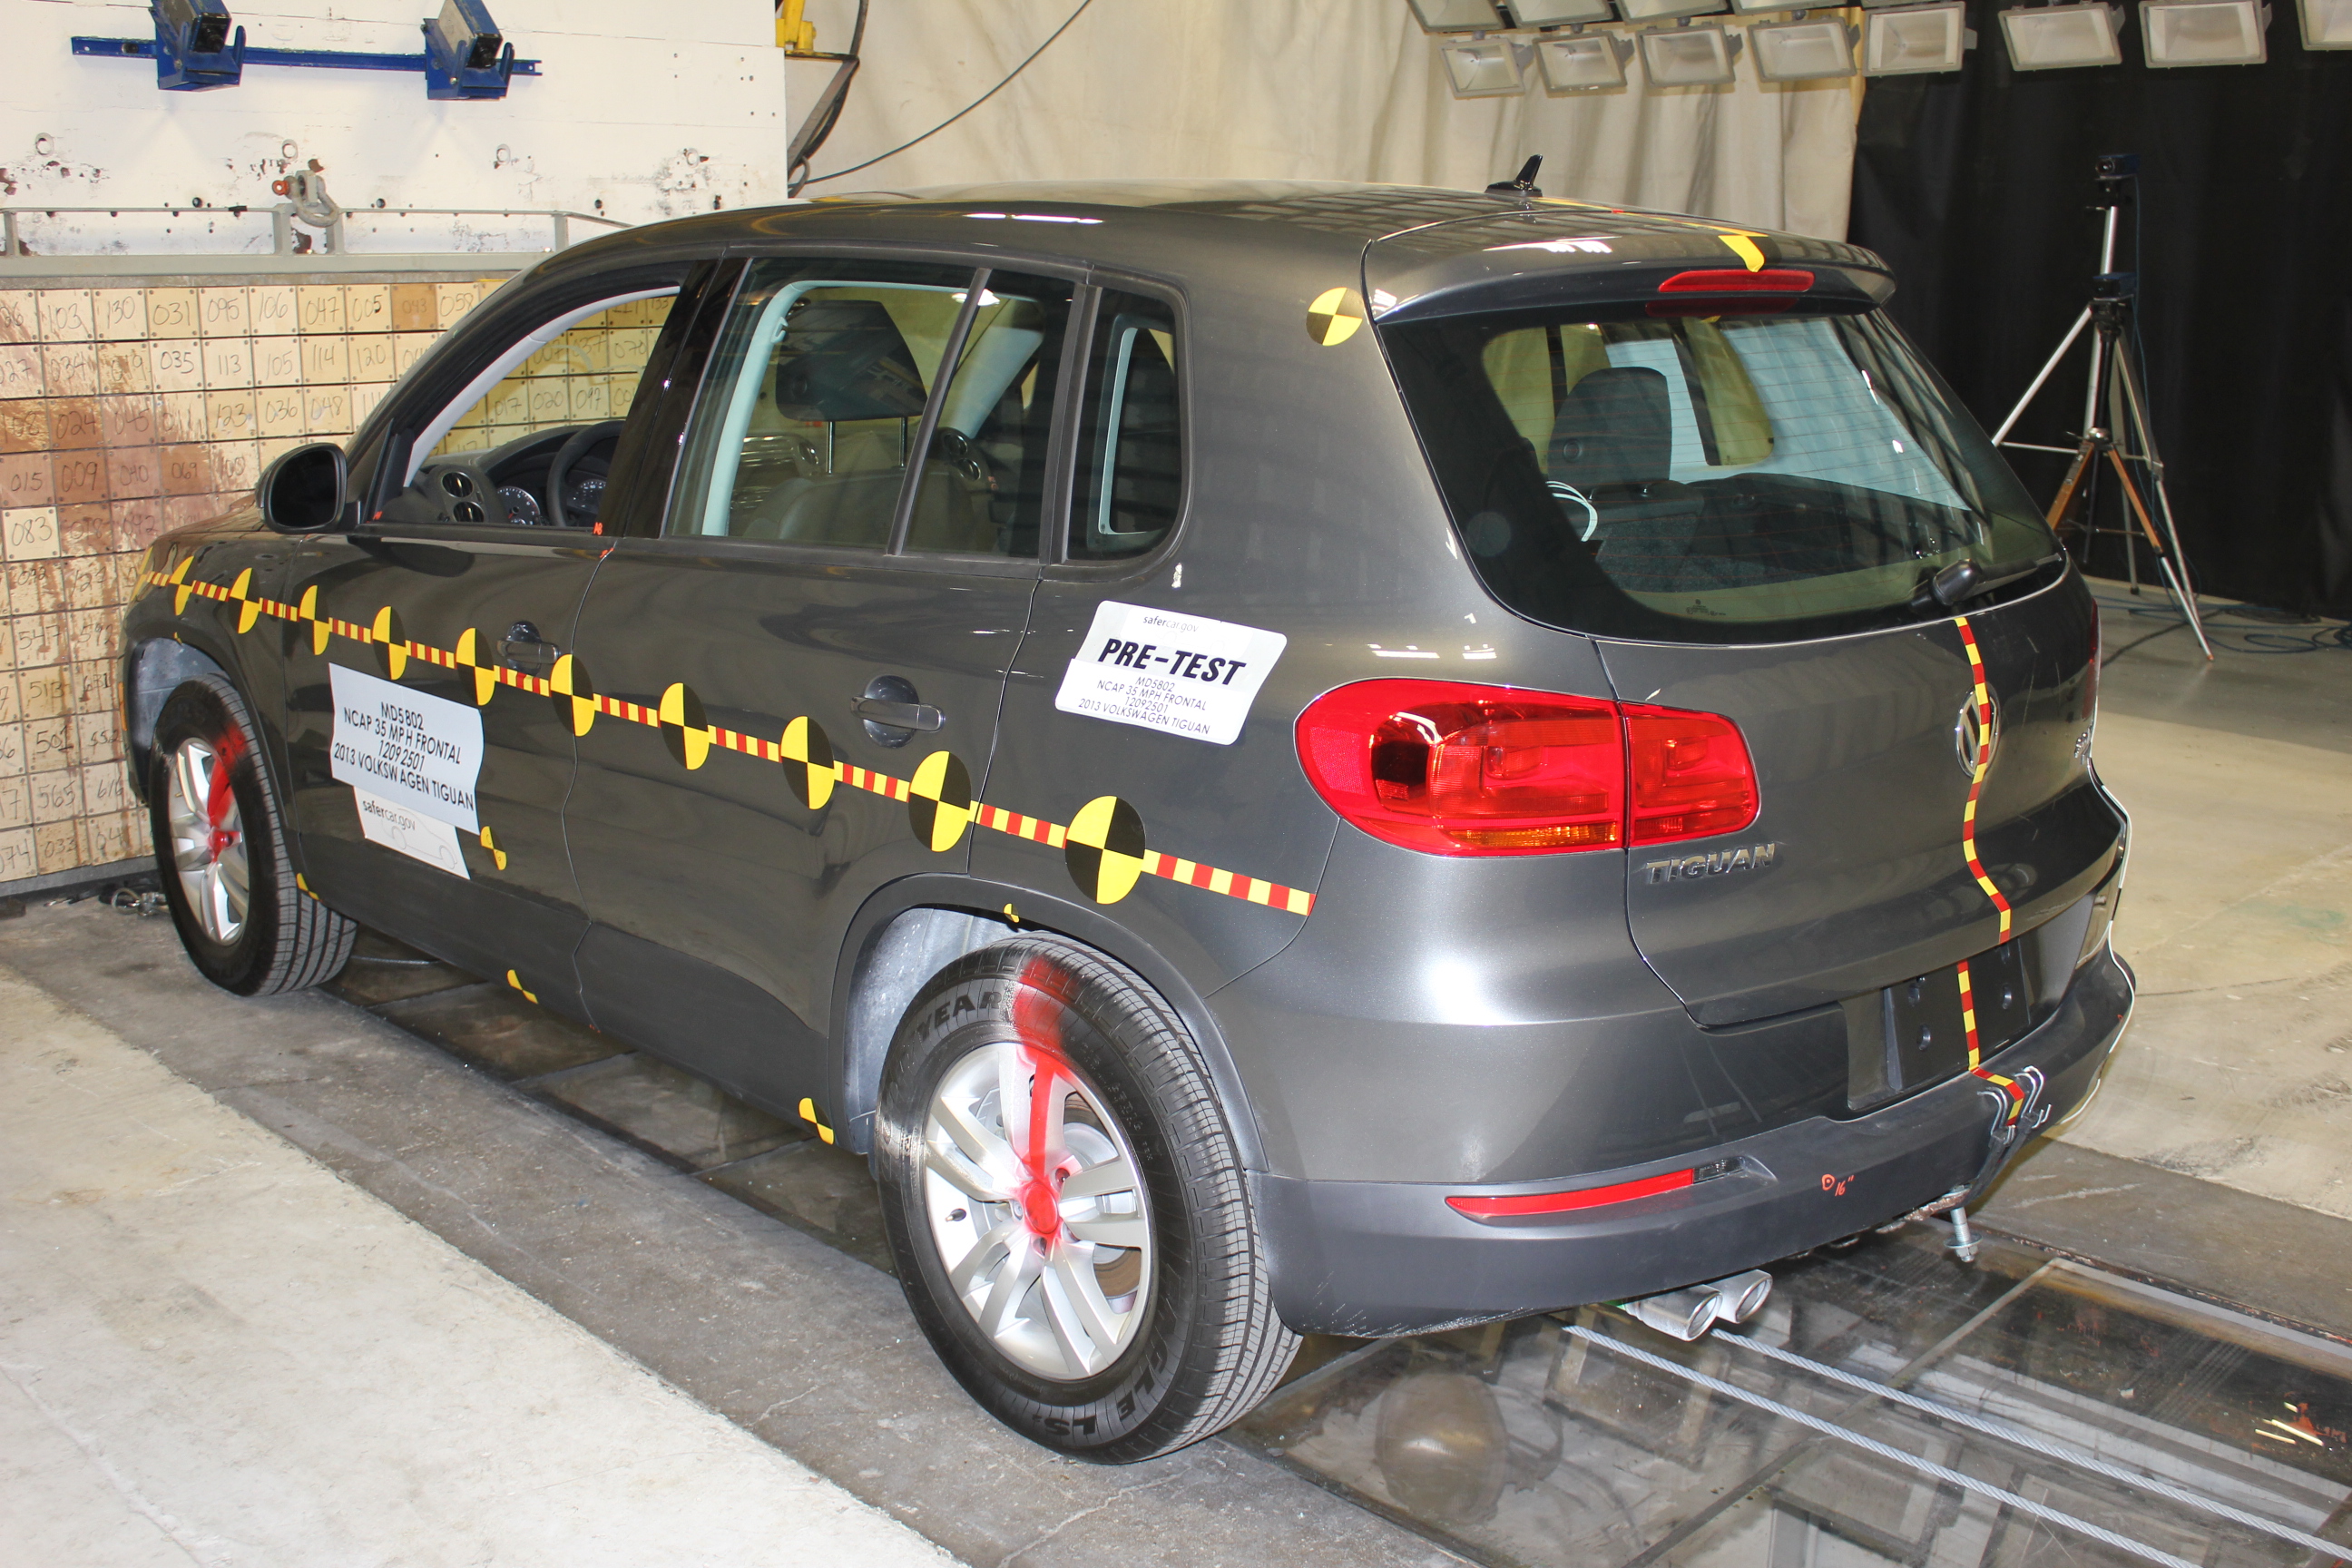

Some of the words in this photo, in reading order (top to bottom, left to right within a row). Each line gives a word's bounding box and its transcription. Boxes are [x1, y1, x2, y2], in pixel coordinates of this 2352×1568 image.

[107, 296, 135, 328] 130
[153, 300, 191, 326] 031
[207, 298, 240, 323] 095
[259, 291, 289, 322] 106
[305, 296, 340, 325] 047
[353, 294, 383, 322] 005
[402, 298, 427, 314] 043
[439, 292, 474, 317] 058
[313, 343, 335, 371] 114
[357, 344, 386, 373] 120
[614, 339, 647, 358] 070
[161, 350, 194, 374] 035
[218, 354, 241, 376] 113
[266, 350, 293, 380] 105
[266, 397, 299, 423] 036
[310, 396, 343, 420] 048
[495, 397, 522, 417] 017
[533, 391, 564, 410] 020
[56, 410, 96, 439] 024
[215, 403, 248, 428] 123
[10, 472, 44, 492] 015
[62, 461, 98, 493] 009
[119, 465, 149, 485] 040
[172, 462, 198, 480] 069
[12, 516, 53, 546] 083
[1142, 614, 1200, 633] safercar.gov
[18, 624, 61, 650] 547
[1098, 637, 1247, 686] PRE-TEST
[30, 681, 65, 699] 513
[1097, 680, 1124, 693] NCAP
[1126, 686, 1137, 697] 35
[1140, 689, 1161, 701] MPH
[1163, 693, 1207, 711] FRONTAL
[1135, 676, 1175, 692] MD5802
[381, 701, 425, 731] MD5802
[1078, 698, 1102, 711] 2013
[1102, 702, 1171, 727] VOLKSWAGEN
[1171, 717, 1210, 735] TIGUAN
[1125, 696, 1169, 713] 12092501
[344, 707, 372, 731] NCAP
[375, 718, 387, 738] 35
[388, 722, 413, 748] MPH
[416, 734, 462, 765] FRONTAL
[378, 740, 426, 773] 12092501
[97, 775, 123, 799] 616
[334, 742, 356, 767] 2013
[358, 752, 430, 795] VOLKSWAGEN
[432, 779, 475, 812] TIGUAN
[37, 780, 76, 808] 565
[362, 799, 416, 831] safercar.gov
[44, 836, 78, 858] 033
[1645, 842, 1776, 885] TIGUAN
